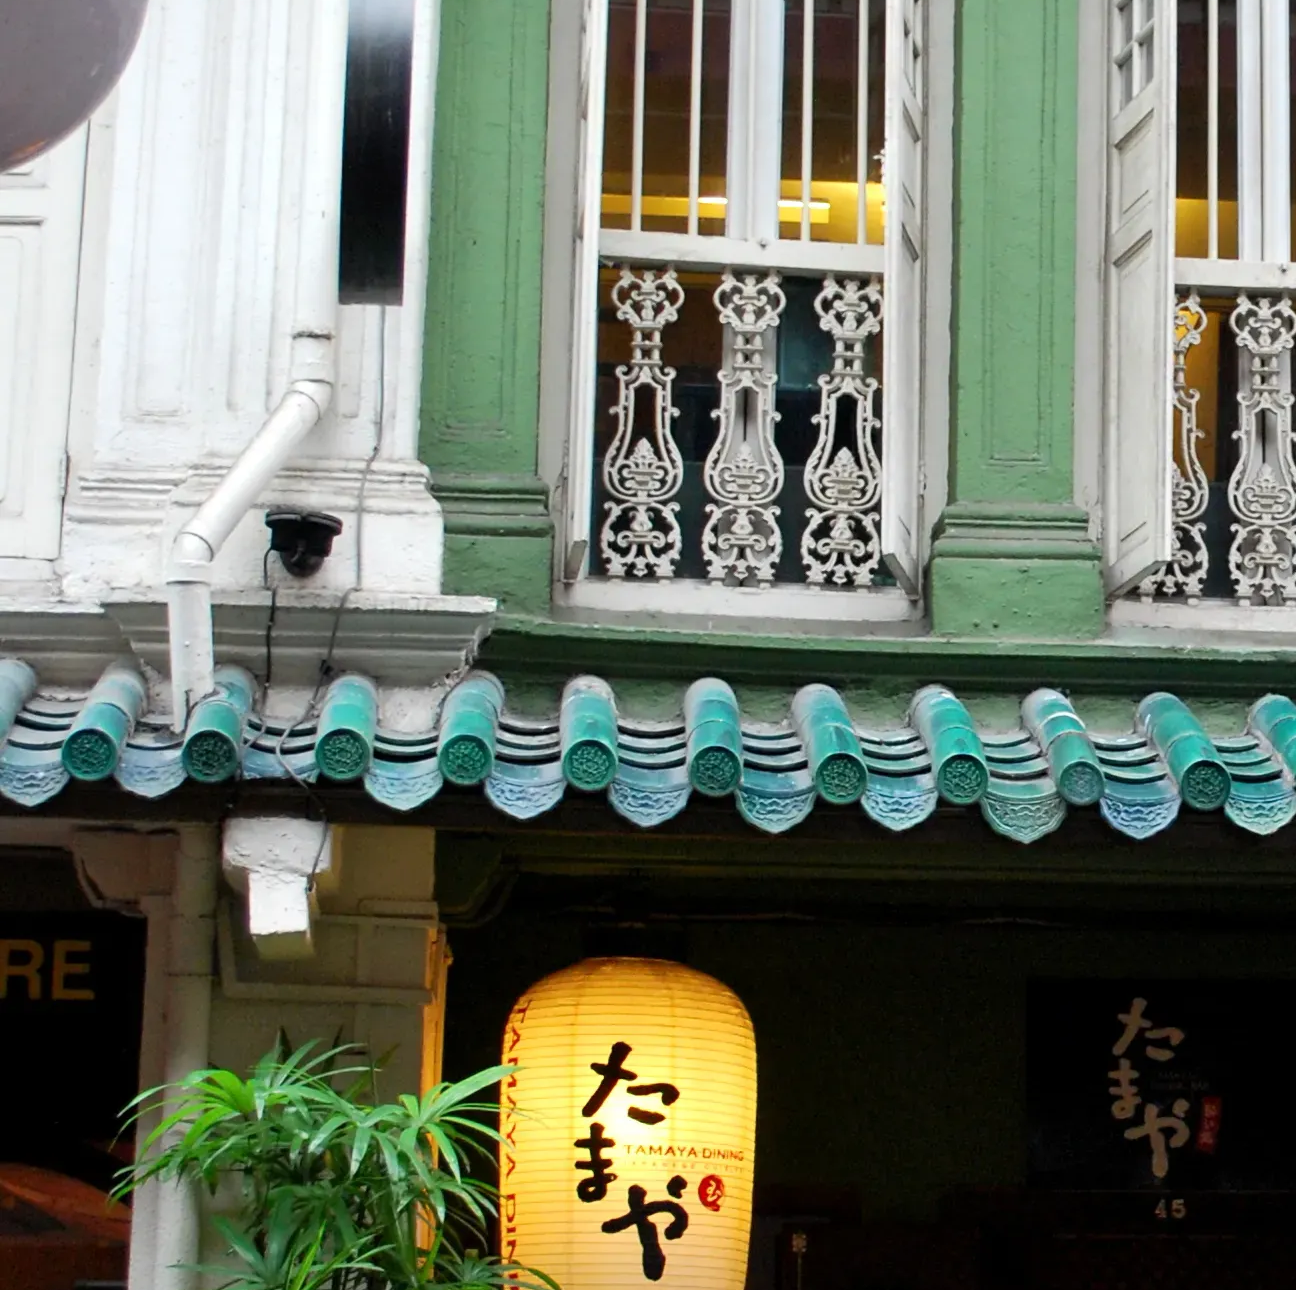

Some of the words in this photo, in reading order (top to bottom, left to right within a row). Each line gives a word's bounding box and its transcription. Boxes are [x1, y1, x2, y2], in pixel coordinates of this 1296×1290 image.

[0, 939, 95, 1000] RE
[506, 999, 532, 1179] TAMAYA
[1108, 997, 1190, 1178] たまや
[574, 1041, 689, 1281] たまや
[624, 1145, 697, 1158] TAMAYA
[702, 1147, 744, 1162] DINING
[1155, 1199, 1187, 1219] 45
